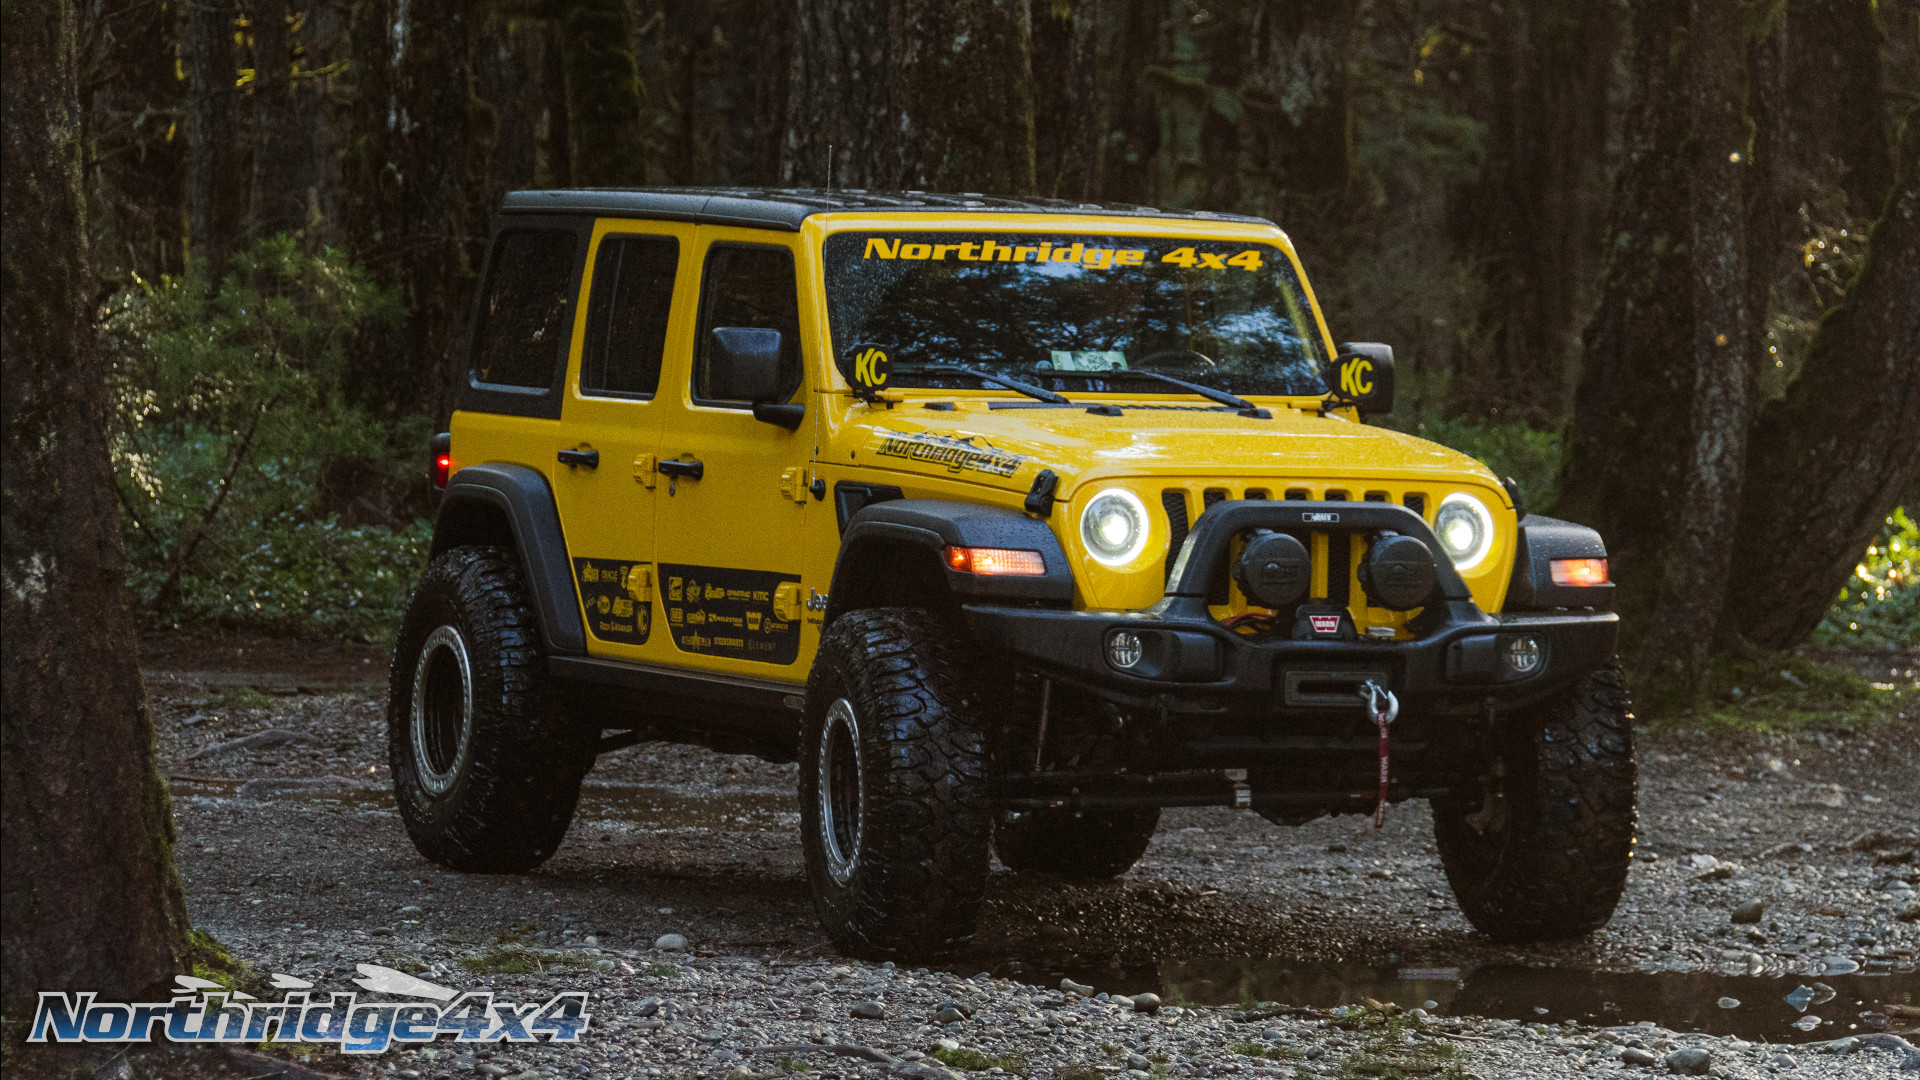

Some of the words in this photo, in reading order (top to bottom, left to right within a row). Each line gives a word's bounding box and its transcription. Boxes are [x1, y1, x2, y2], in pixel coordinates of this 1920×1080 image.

[864, 238, 1145, 270] Northridge
[1161, 246, 1264, 272] 4x4
[855, 347, 888, 388] KC
[1340, 357, 1374, 397] KC
[1315, 620, 1336, 628] WARN
[1381, 756, 1389, 783] WARN
